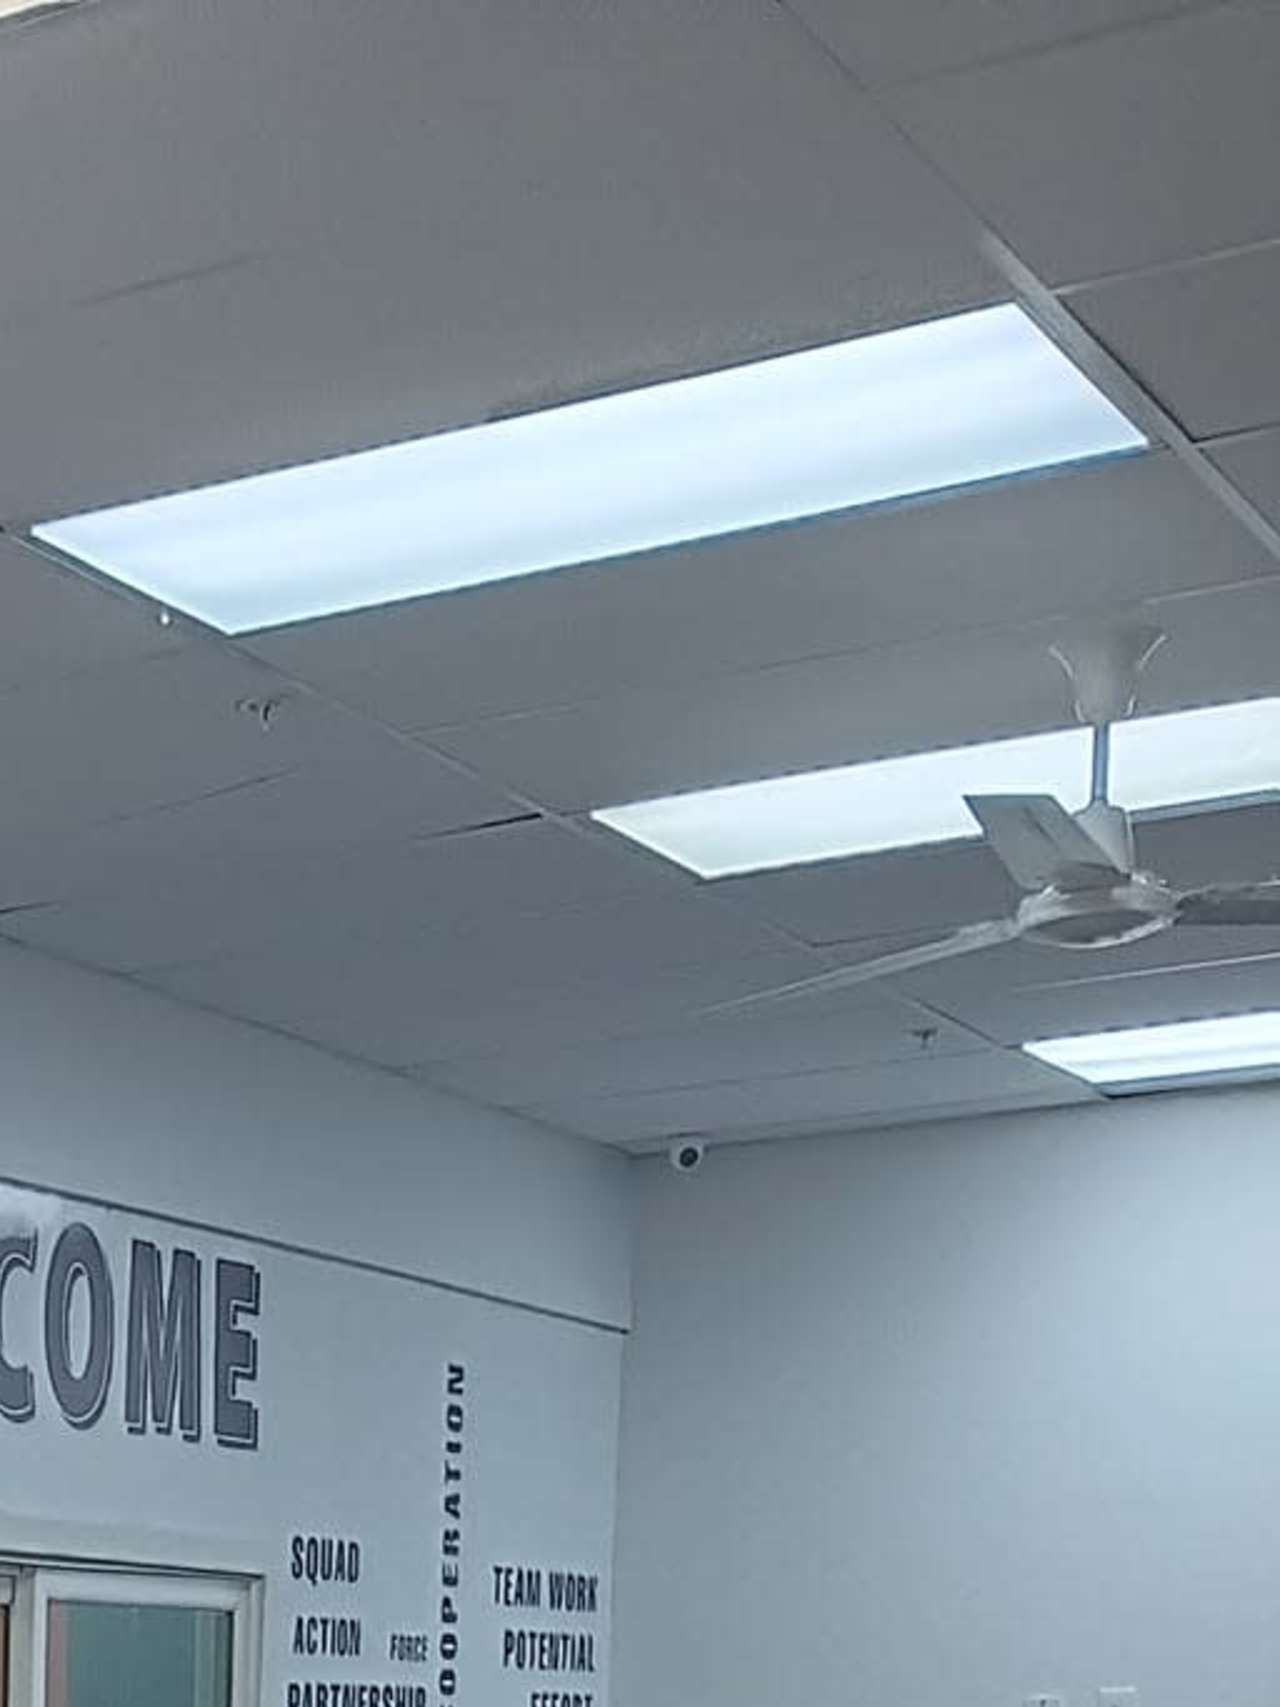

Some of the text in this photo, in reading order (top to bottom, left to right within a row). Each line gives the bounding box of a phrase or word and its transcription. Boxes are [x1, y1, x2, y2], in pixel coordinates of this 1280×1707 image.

[291, 1534, 360, 1584] SQUAD
[492, 1565, 598, 1613] TEAM WORK
[292, 1616, 361, 1657] ACTION
[389, 1632, 429, 1663] FORCE
[503, 1629, 595, 1673] POTENTIAL
